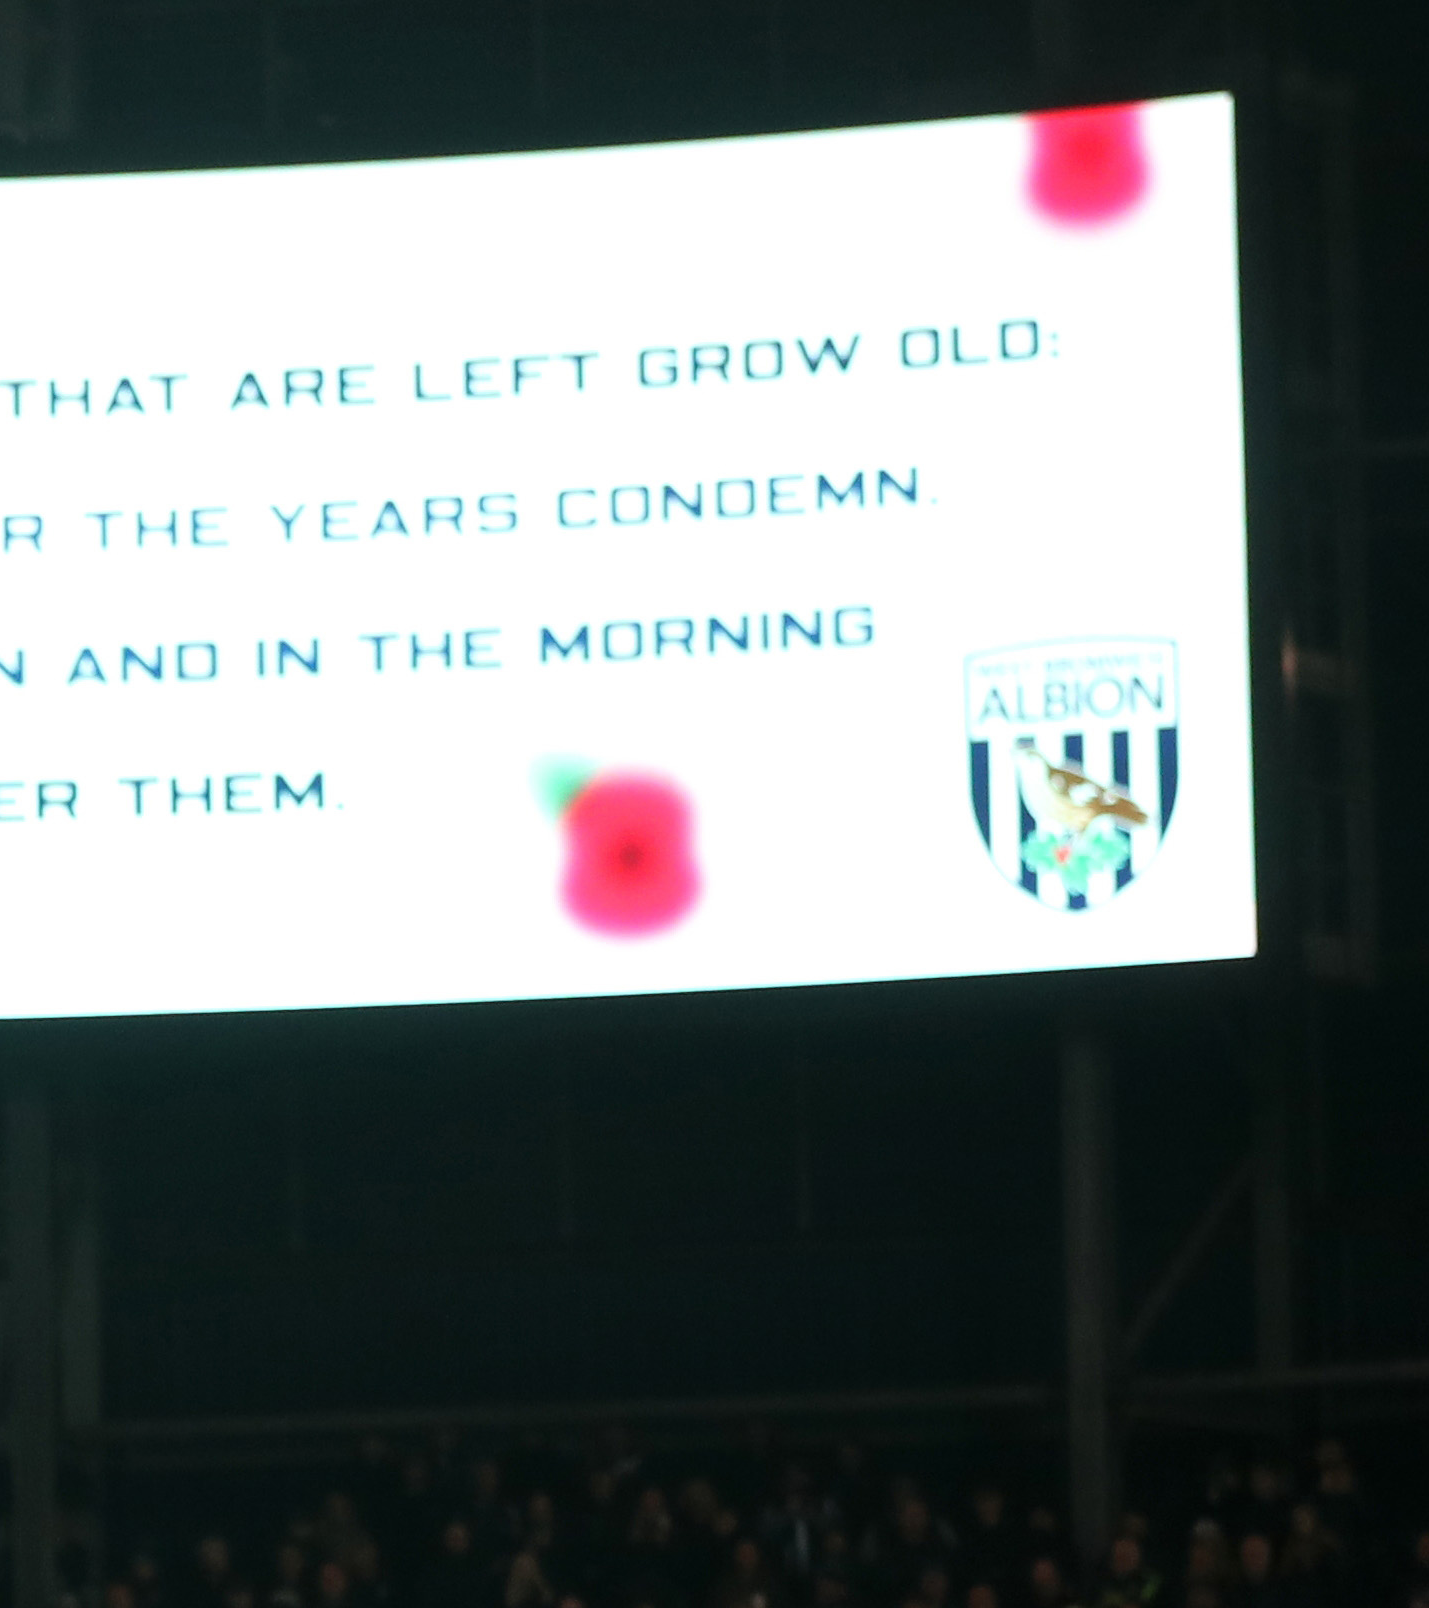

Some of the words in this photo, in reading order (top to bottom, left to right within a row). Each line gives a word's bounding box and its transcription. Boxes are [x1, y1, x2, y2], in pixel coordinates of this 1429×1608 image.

[229, 365, 376, 411] ARE
[413, 351, 599, 402] LEFT
[638, 332, 861, 390] GROW
[84, 507, 229, 550] THE
[269, 492, 519, 543] YEARS
[66, 640, 219, 686] AND
[254, 636, 322, 679] IN
[358, 627, 503, 673] THE
[537, 605, 877, 666] MORNING
[978, 673, 1164, 724] ALBION
